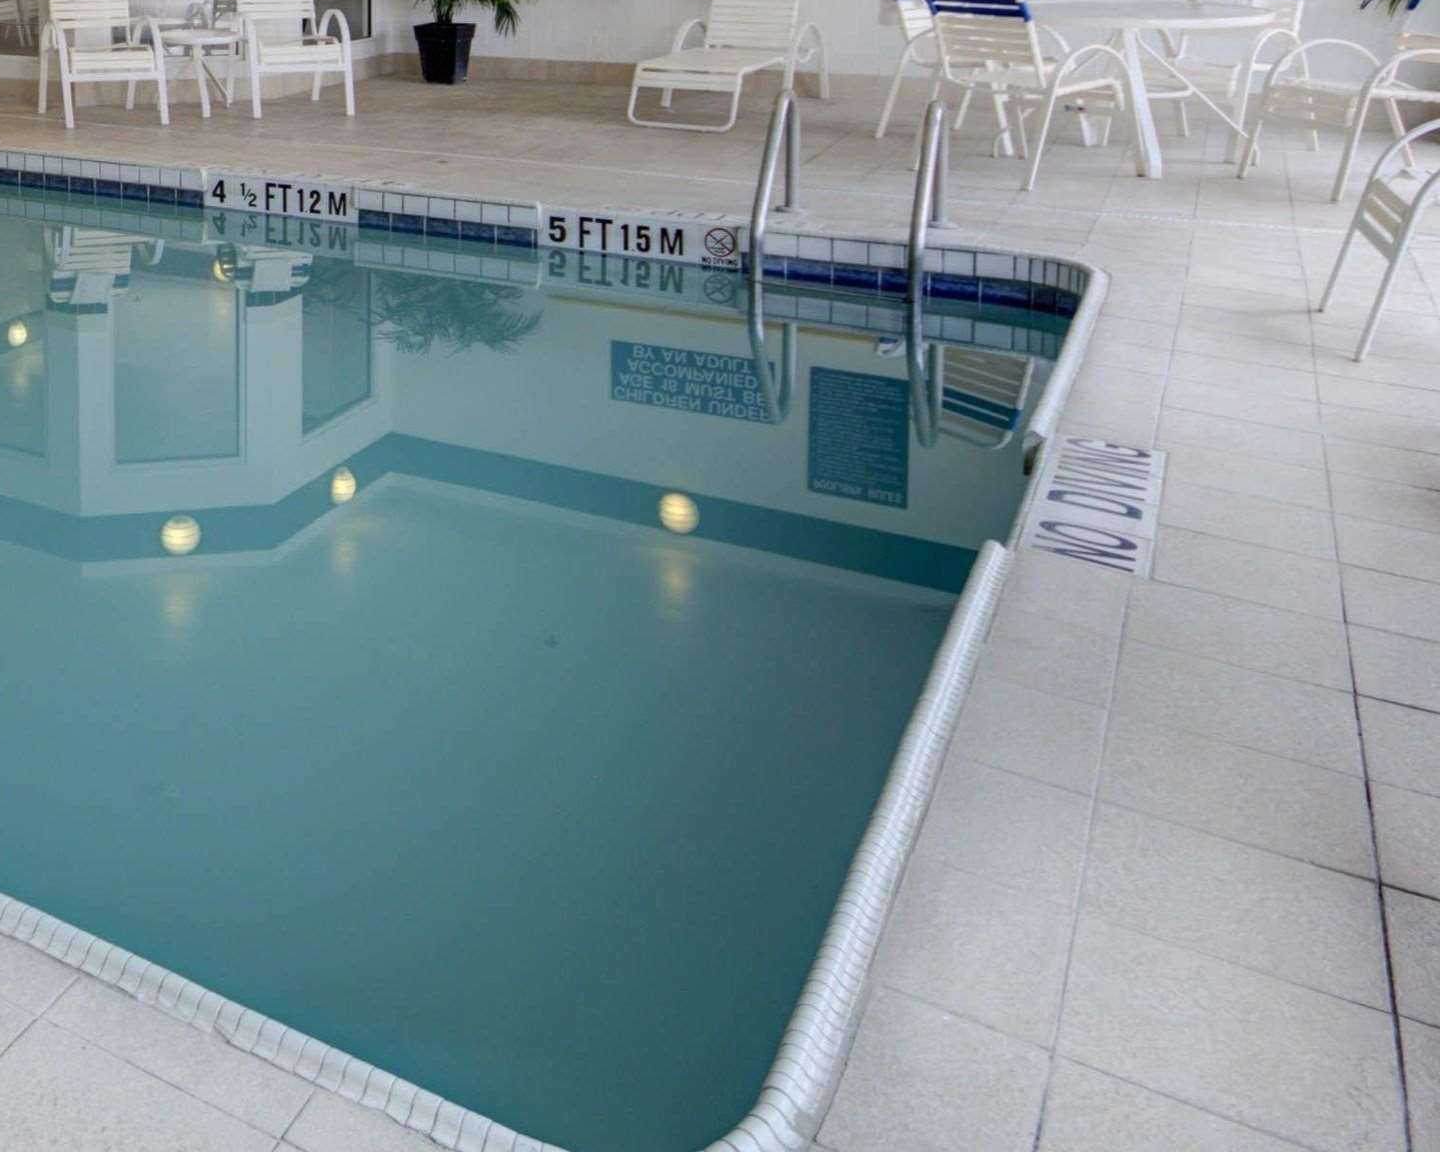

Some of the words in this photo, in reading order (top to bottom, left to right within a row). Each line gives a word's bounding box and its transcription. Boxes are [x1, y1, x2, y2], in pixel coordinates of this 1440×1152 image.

[212, 180, 226, 203] 4
[265, 182, 292, 212] FT
[549, 216, 566, 242] 5
[579, 216, 613, 251] FT
[702, 256, 711, 264] NO
[1047, 437, 1152, 520] DIVING
[1032, 520, 1138, 573] NO
